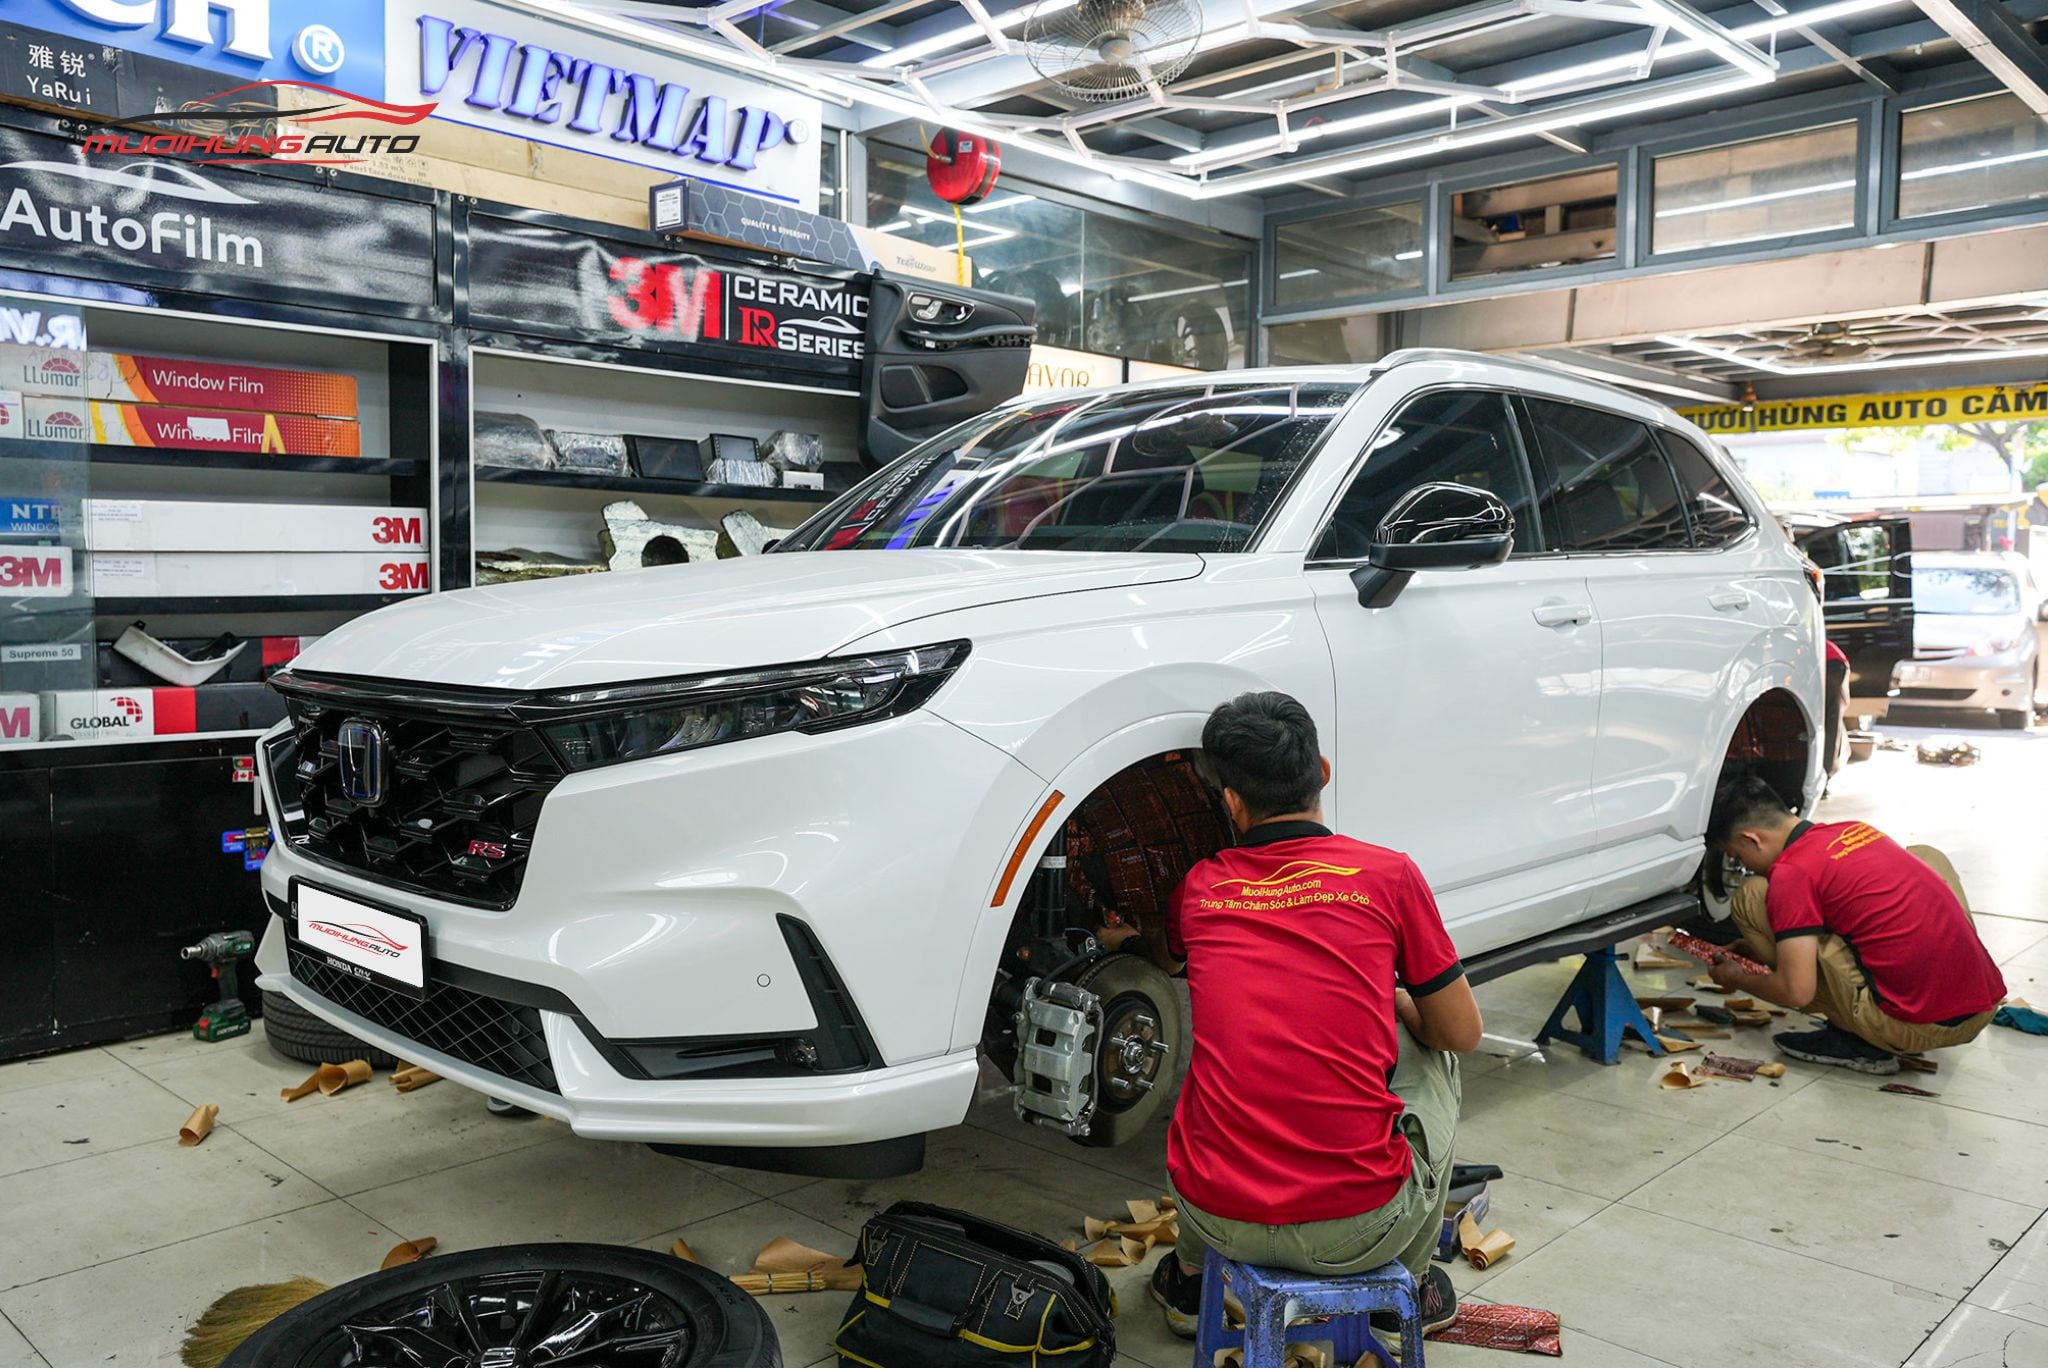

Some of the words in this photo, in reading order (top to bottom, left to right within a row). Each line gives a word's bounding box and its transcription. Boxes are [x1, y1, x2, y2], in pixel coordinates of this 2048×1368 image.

[27, 74, 92, 106] YaRui
[740, 216, 771, 232] QUALITY
[778, 226, 811, 241] DIVERSITY
[608, 256, 721, 341] 3M
[734, 274, 870, 318] CERAMIC
[152, 369, 225, 392] Window
[228, 377, 264, 395] Film
[1758, 403, 1847, 426] HÙNG
[1859, 398, 1946, 421] AUTO
[372, 517, 421, 544] 3M
[0, 556, 61, 587] 3M
[379, 563, 429, 590] 3M
[9, 648, 58, 660] Supreme
[61, 648, 73, 657] 50
[70, 716, 129, 730] GLOBAL
[468, 840, 507, 859] RS
[1200, 899, 1224, 909] Trung
[1269, 899, 1285, 909] Sóc
[1287, 898, 1293, 906] &
[1294, 895, 1312, 905] Làm
[1313, 892, 1334, 904] Đẹp
[1336, 891, 1349, 901] Xe
[327, 956, 352, 973] HONDA
